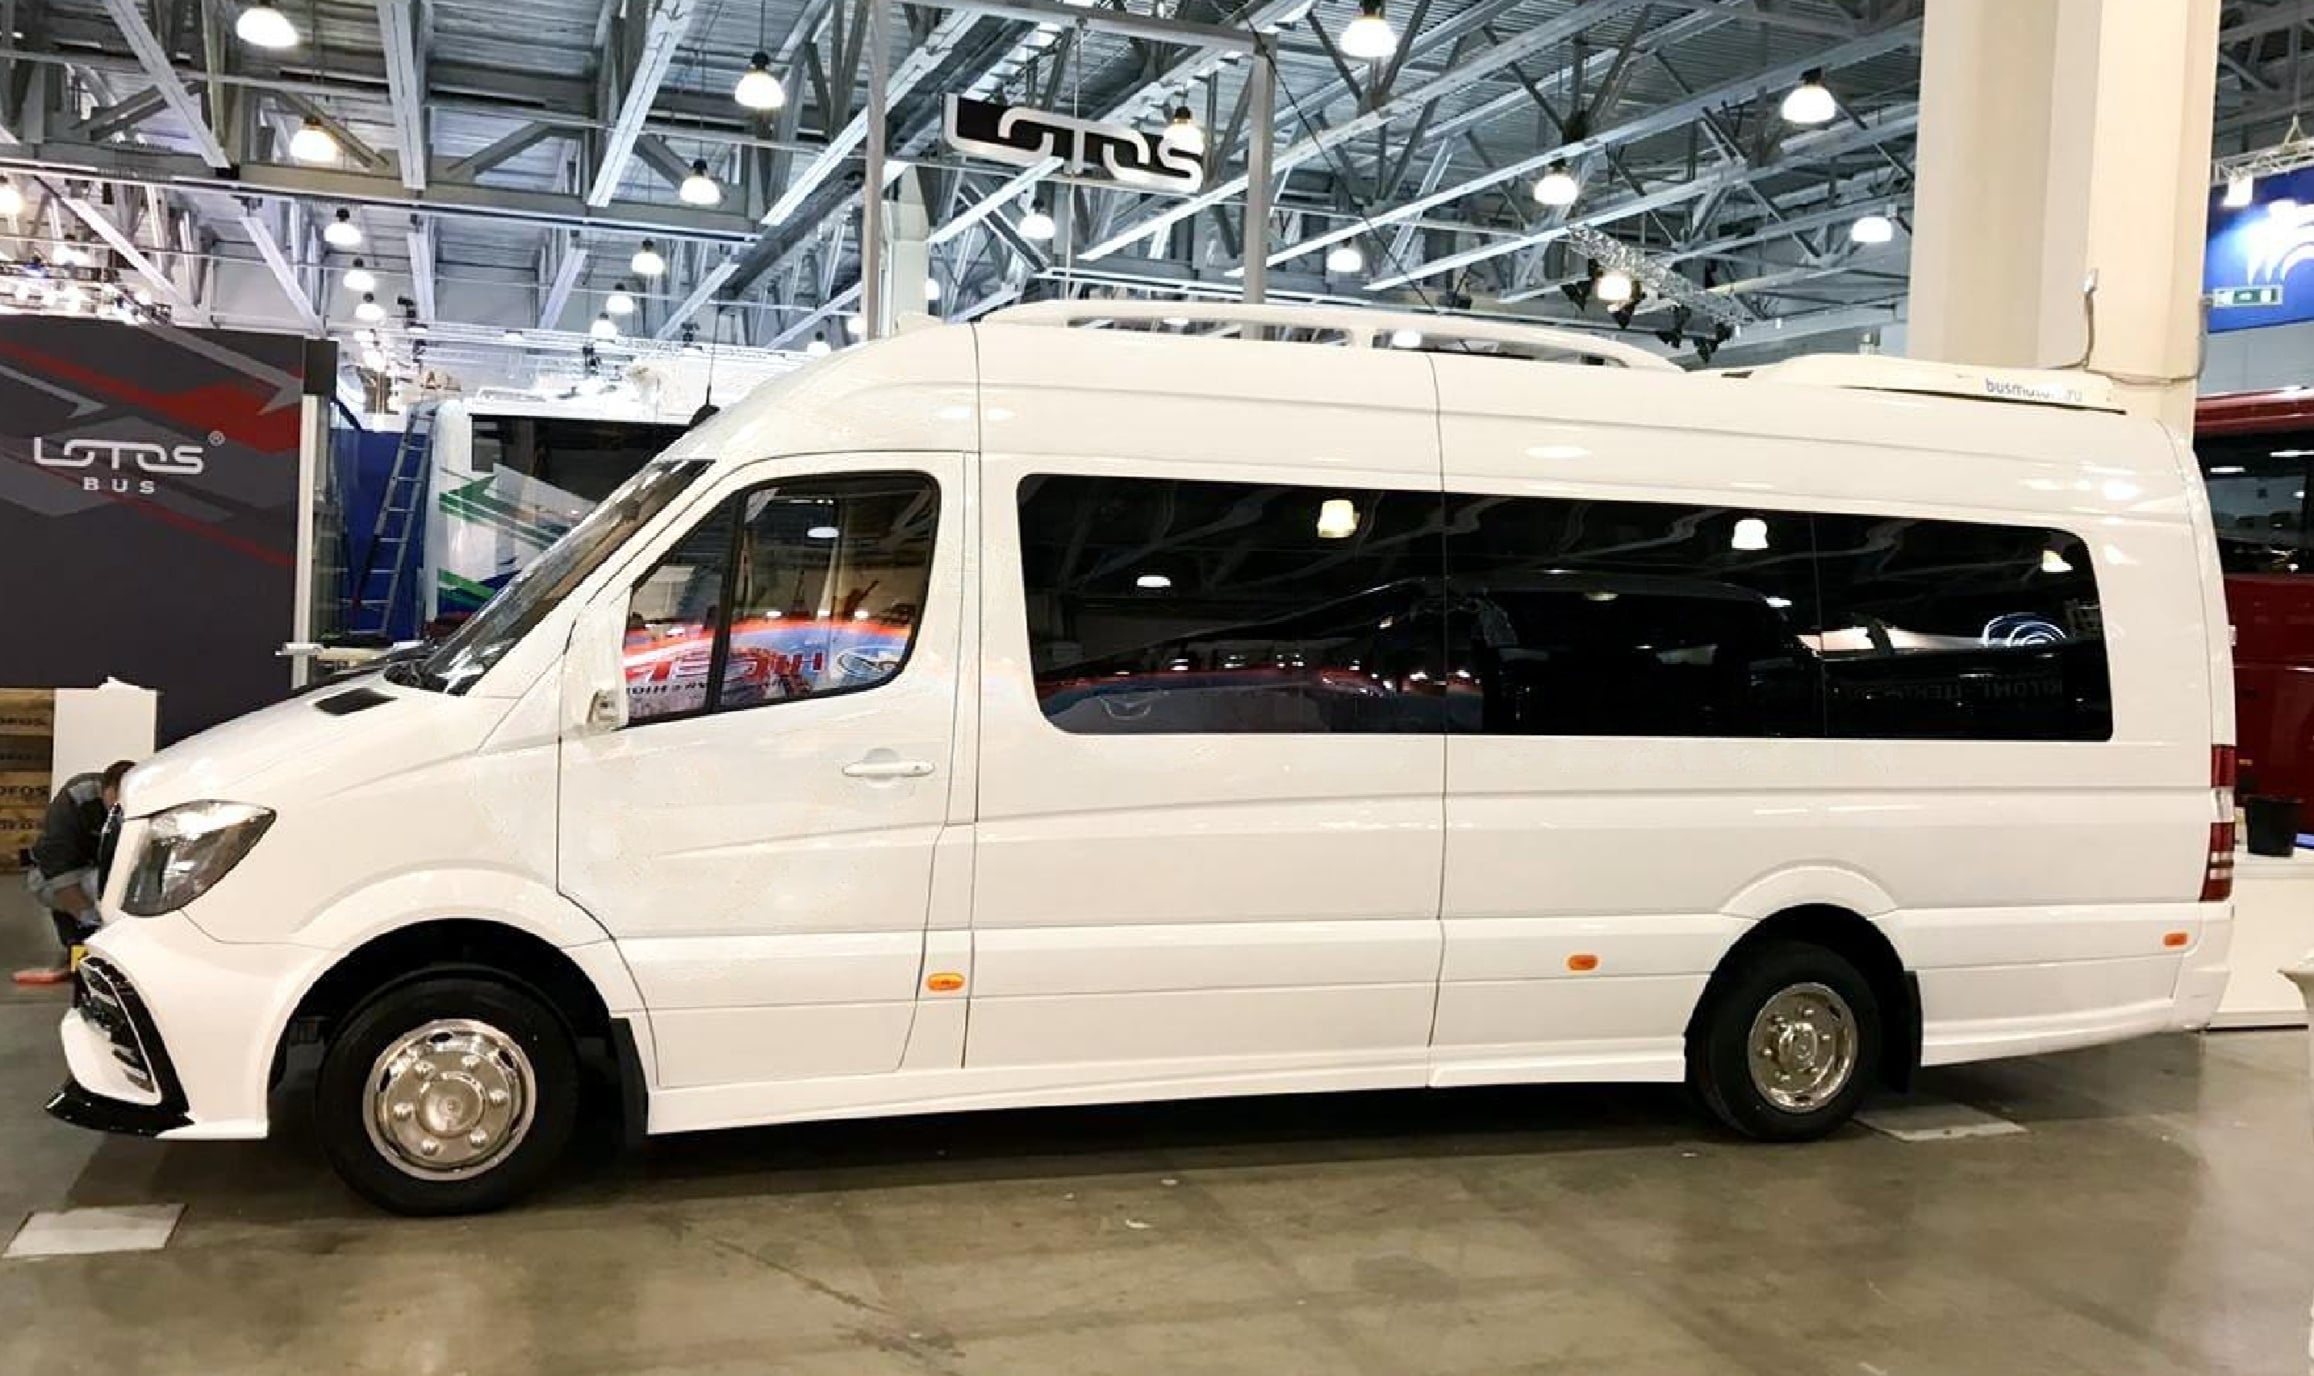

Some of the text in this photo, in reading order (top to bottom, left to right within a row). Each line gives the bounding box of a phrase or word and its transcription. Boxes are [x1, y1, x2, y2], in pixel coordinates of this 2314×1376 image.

[943, 92, 1204, 194] LOTOS
[33, 436, 204, 475] LOTOS
[83, 476, 155, 494] BUS
